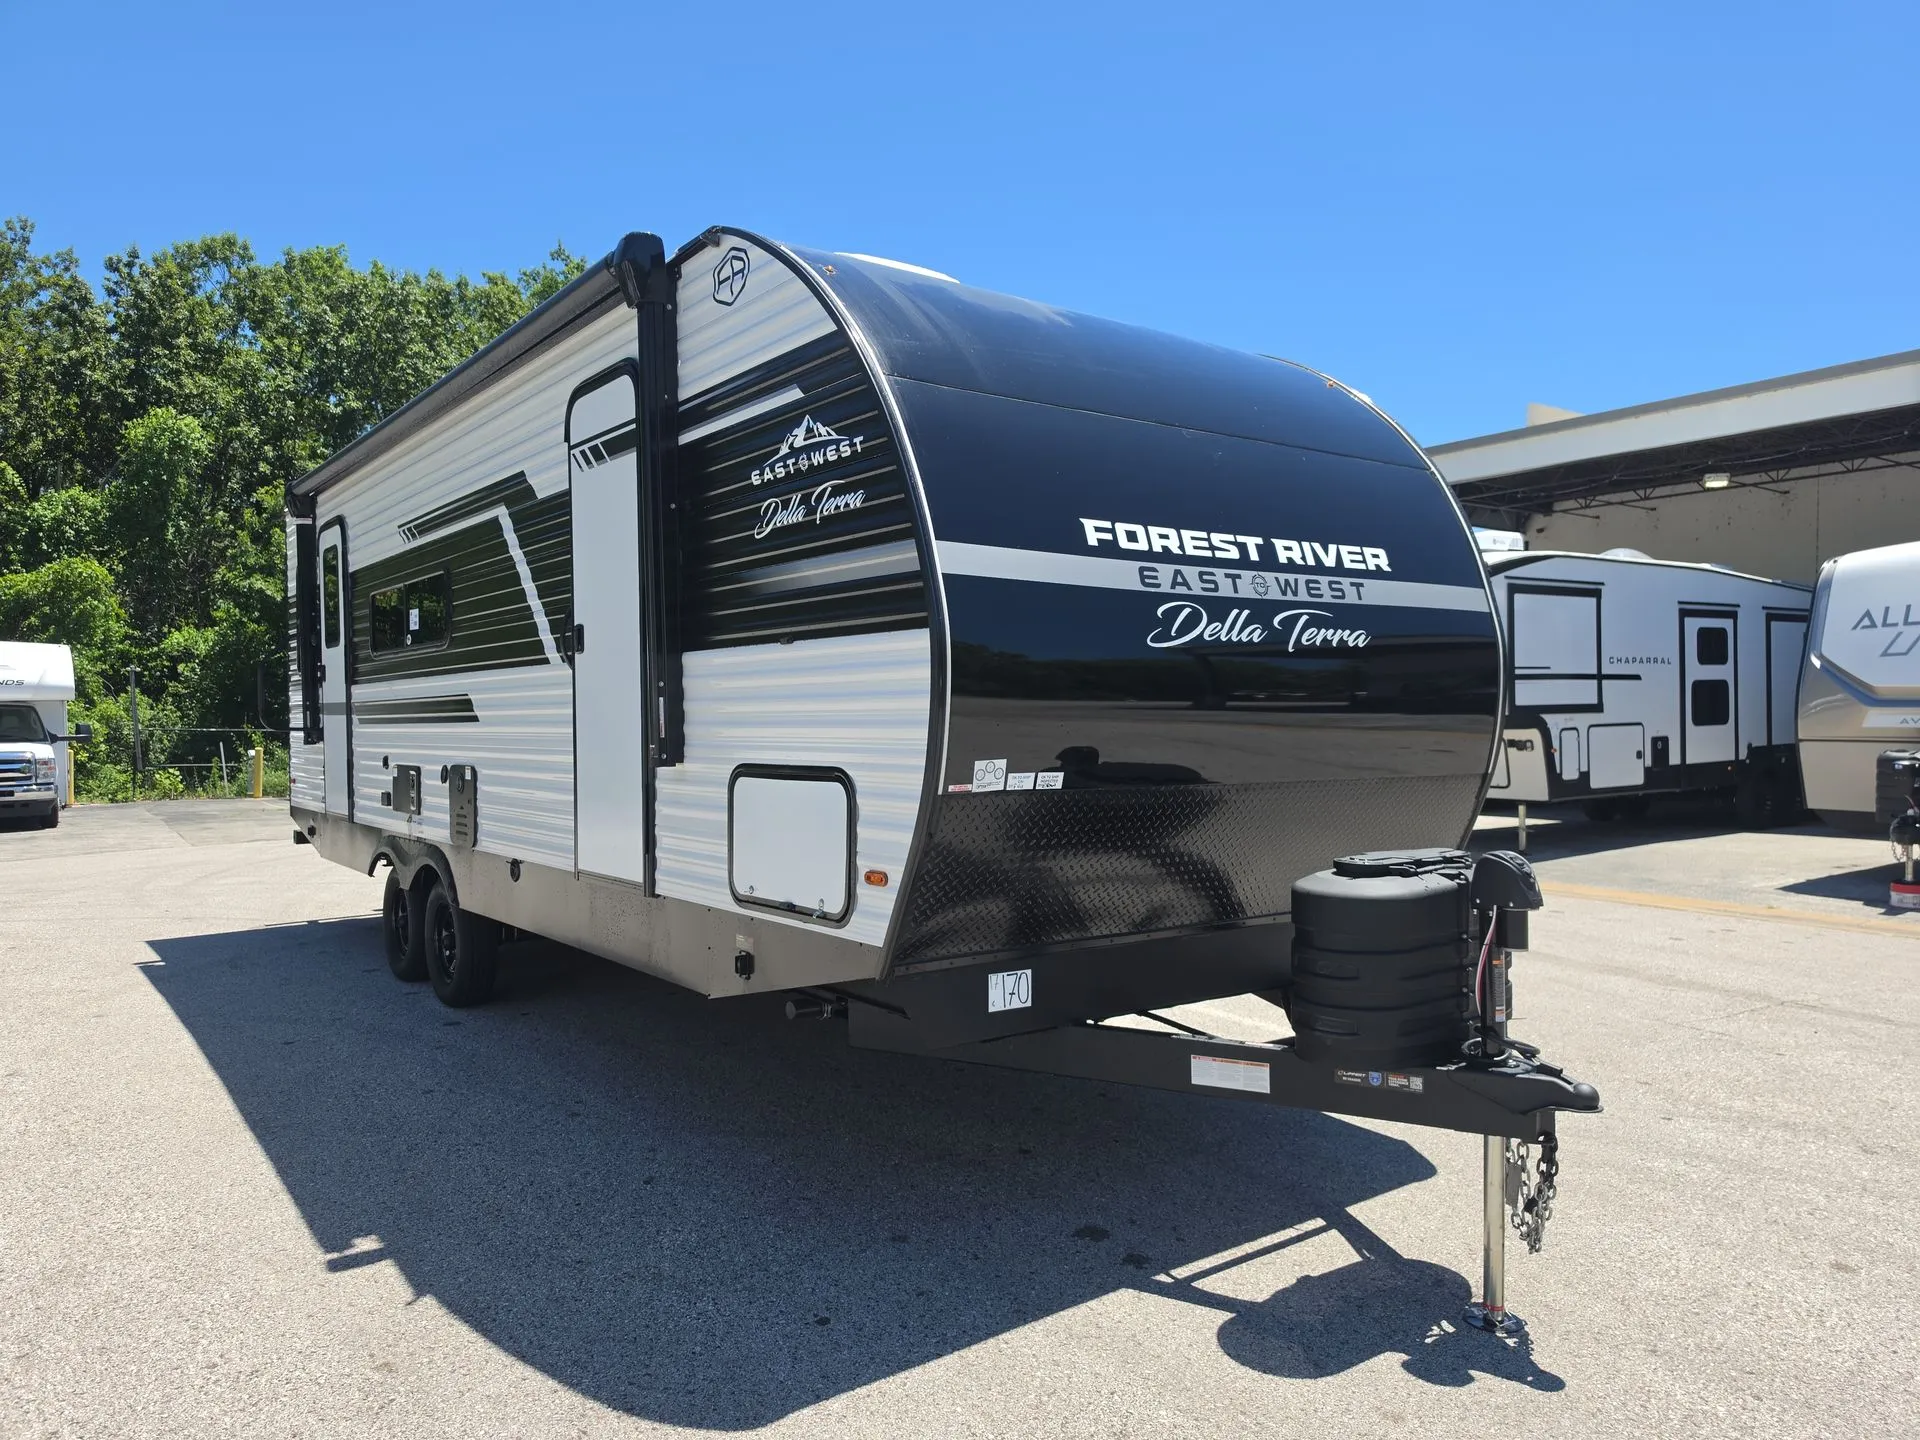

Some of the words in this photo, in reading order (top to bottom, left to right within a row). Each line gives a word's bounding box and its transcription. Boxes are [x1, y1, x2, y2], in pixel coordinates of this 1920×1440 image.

[751, 458, 796, 486] EAST
[811, 436, 864, 466] WEST
[754, 494, 807, 539] Della
[811, 480, 866, 524] Terra
[1079, 517, 1264, 561] FOREST
[1270, 538, 1392, 572] RIVER
[1138, 565, 1242, 594] EAST
[1274, 576, 1365, 601] WEST
[1147, 601, 1267, 649] Della
[1273, 609, 1371, 653] Terra
[1608, 656, 1672, 665] CHAPARRAL
[1002, 971, 1030, 1009] 170
